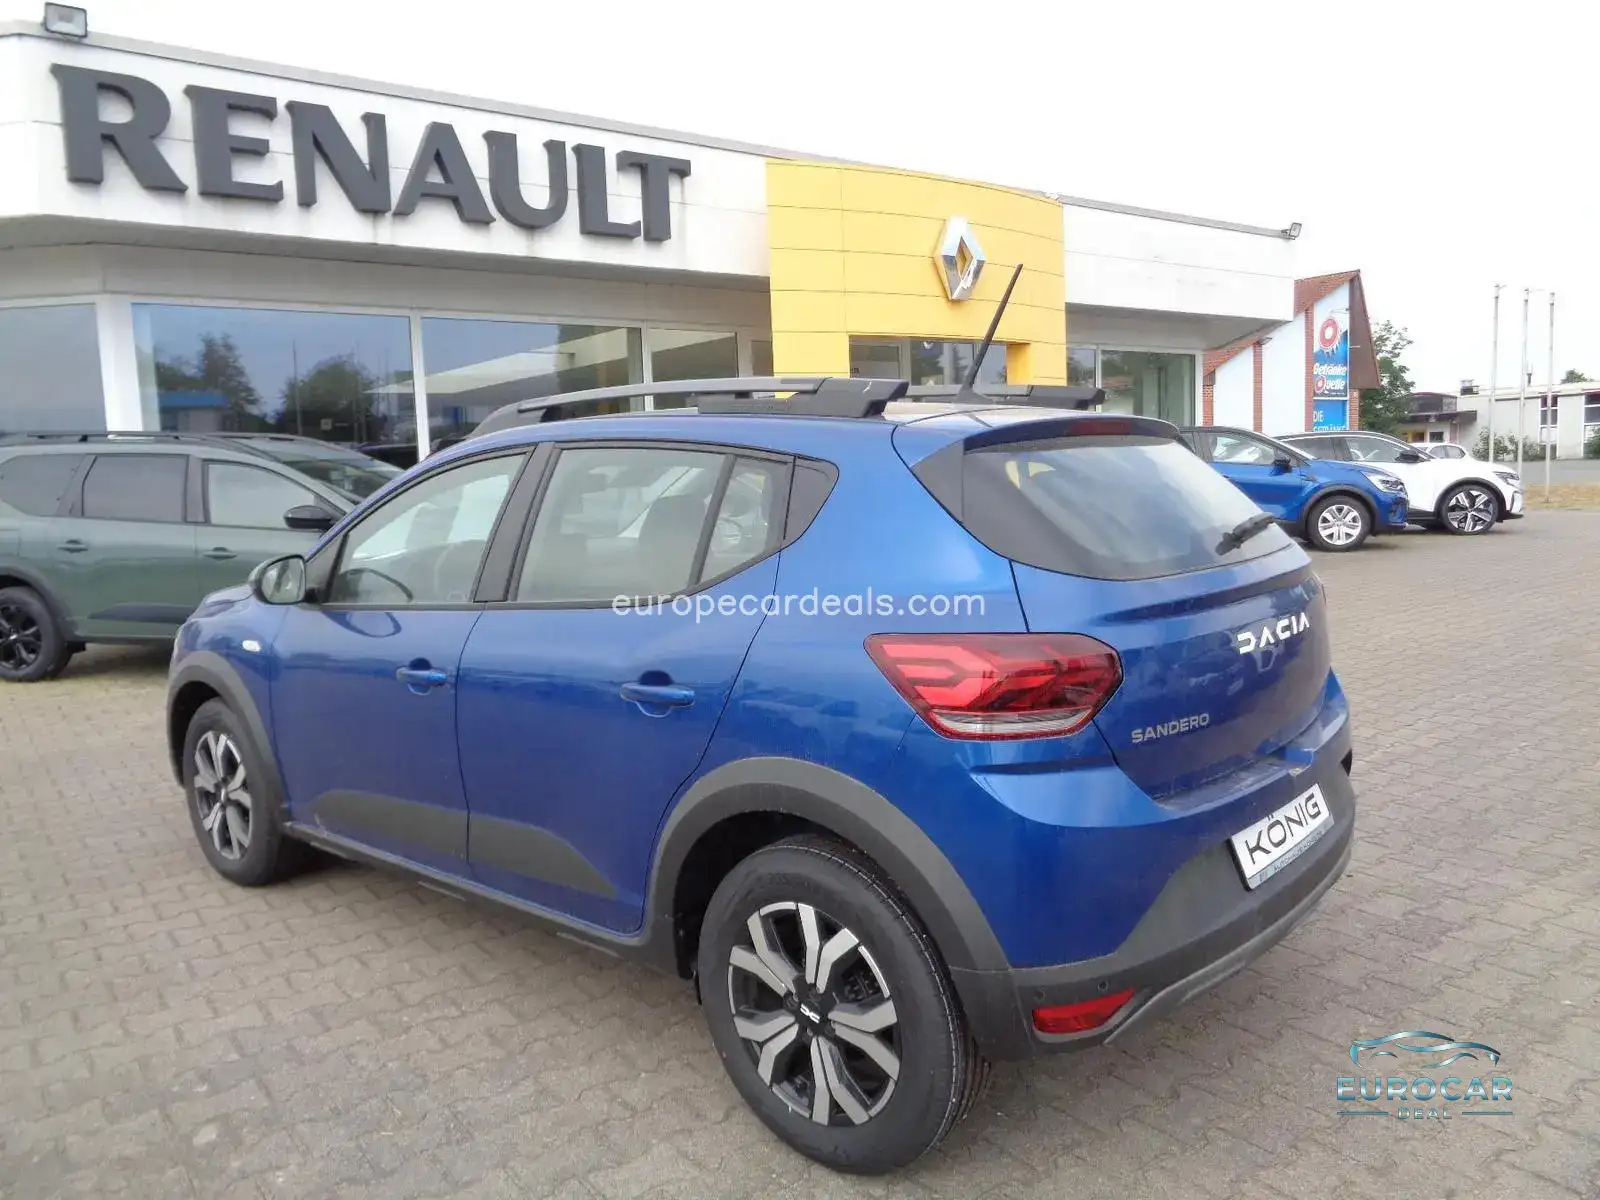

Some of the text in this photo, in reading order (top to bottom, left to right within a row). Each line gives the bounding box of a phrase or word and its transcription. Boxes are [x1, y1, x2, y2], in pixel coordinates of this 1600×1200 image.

[50, 63, 691, 242] RENAULT
[1313, 410, 1324, 422] DIE
[1236, 612, 1310, 654] DACIA
[1131, 712, 1210, 744] SANDERO
[1244, 792, 1322, 865] KÖNIG
